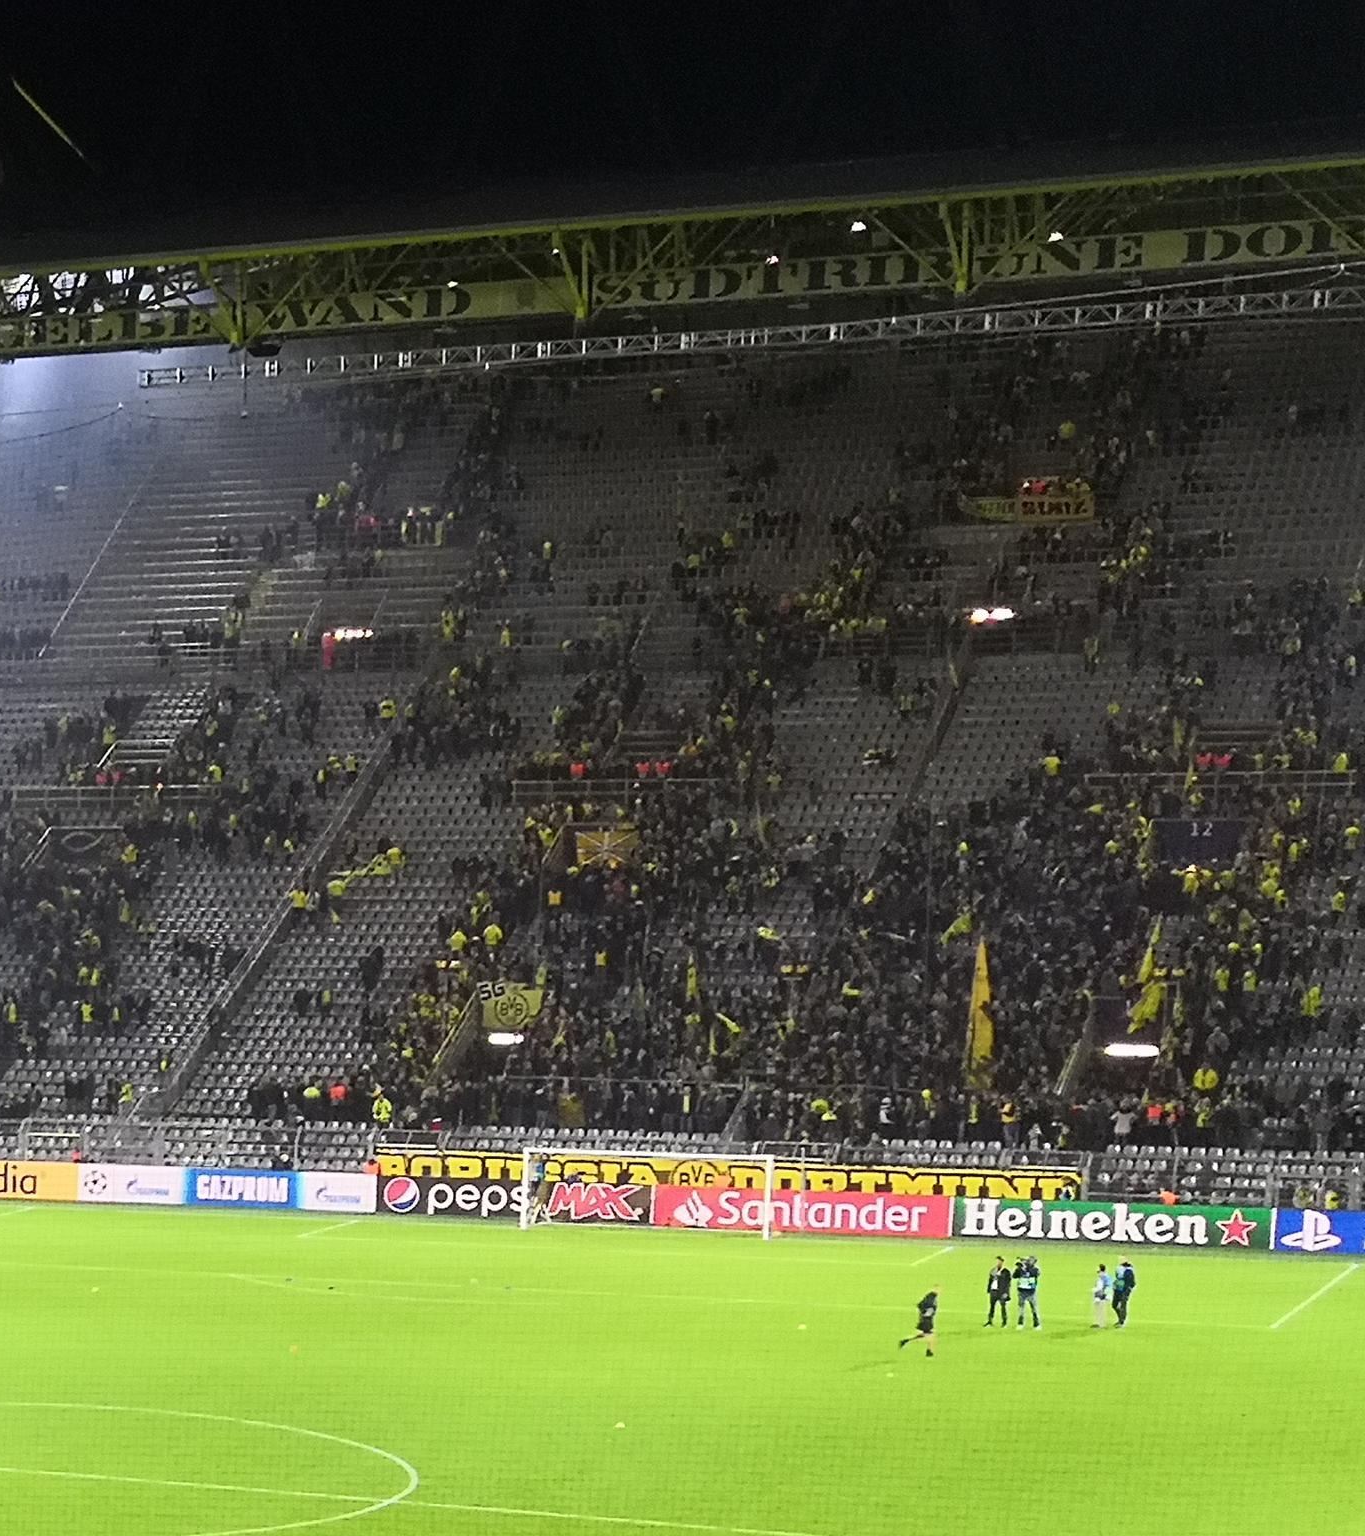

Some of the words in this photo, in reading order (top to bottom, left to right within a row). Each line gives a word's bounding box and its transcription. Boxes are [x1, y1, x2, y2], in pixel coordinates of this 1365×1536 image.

[256, 285, 472, 330] WAND
[1190, 821, 1214, 837] 12
[196, 1174, 289, 1203] GAZPROM
[427, 1182, 529, 1217] peps
[549, 1182, 644, 1221] MAX
[717, 1190, 928, 1233] Santander
[962, 1197, 1209, 1245] Heineken
